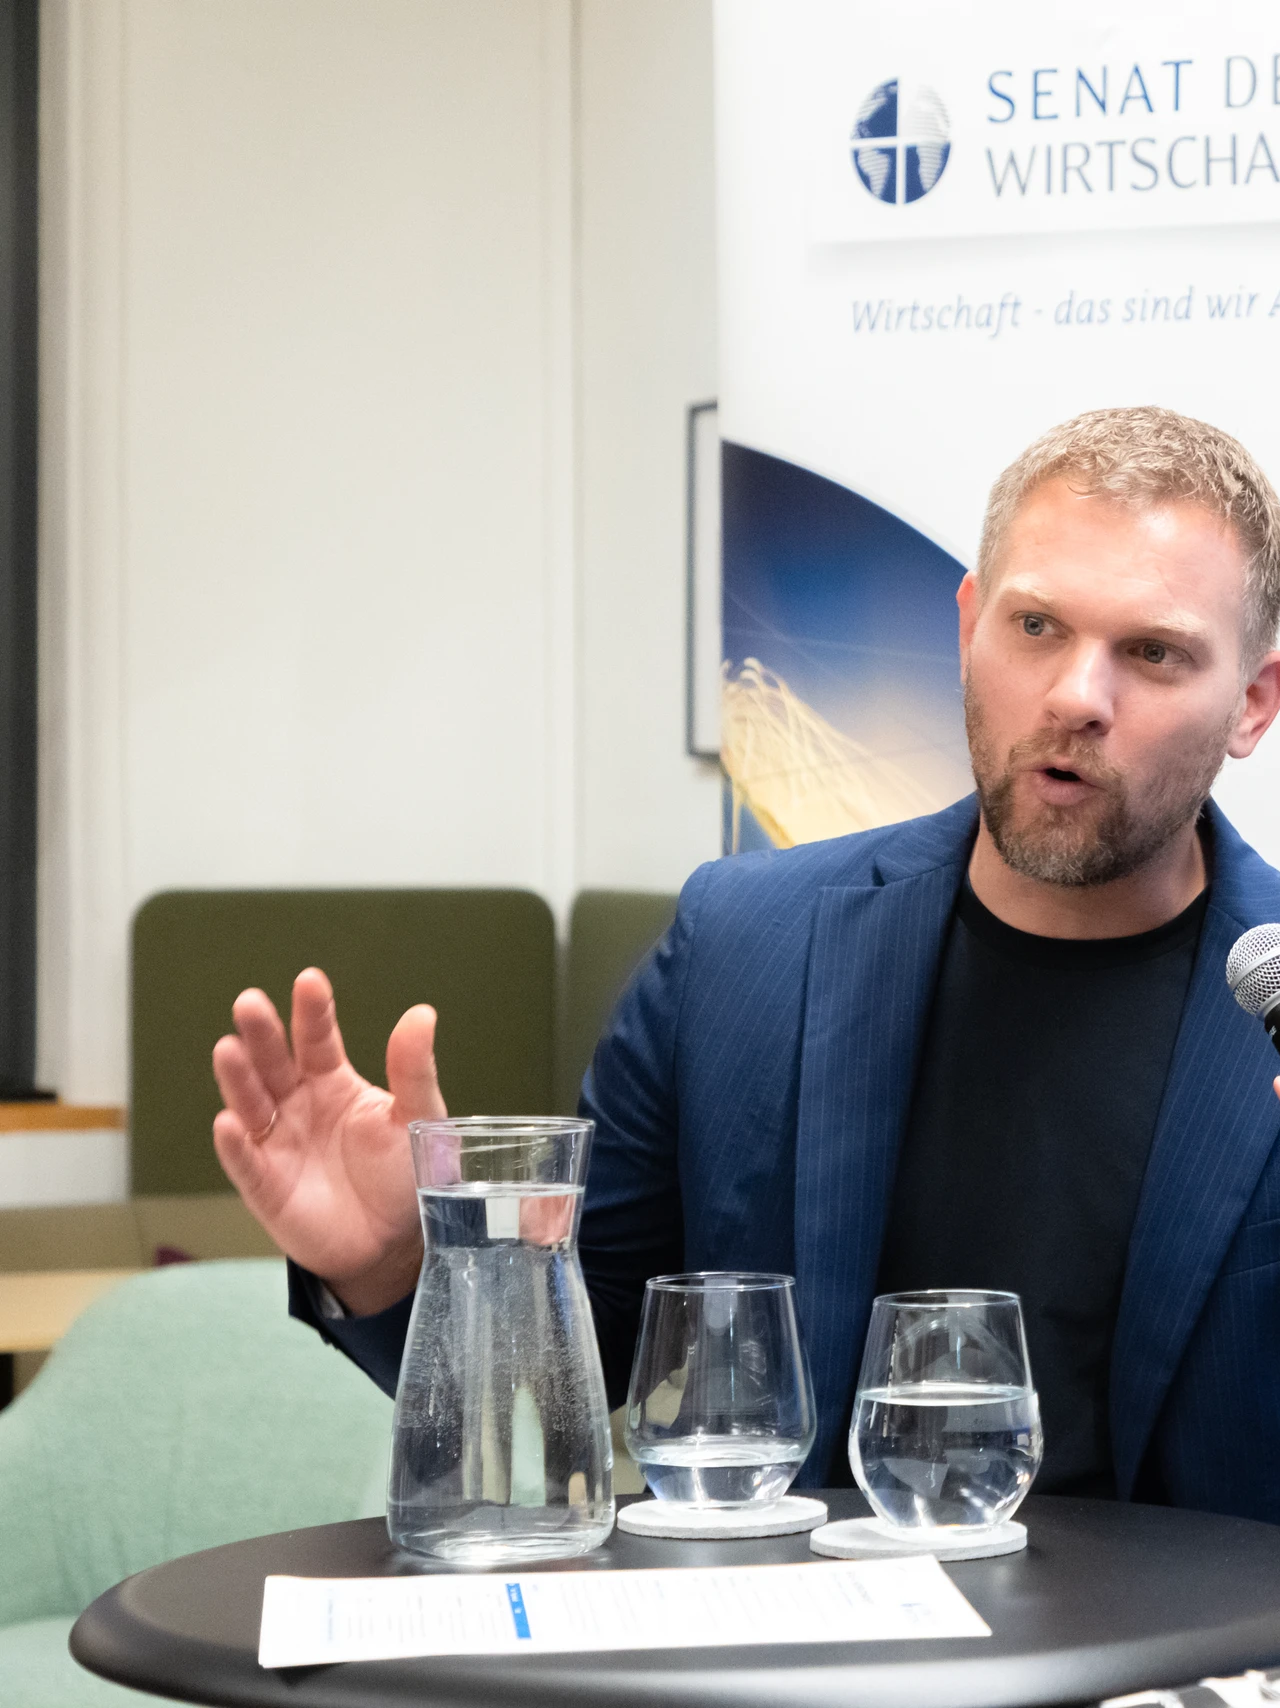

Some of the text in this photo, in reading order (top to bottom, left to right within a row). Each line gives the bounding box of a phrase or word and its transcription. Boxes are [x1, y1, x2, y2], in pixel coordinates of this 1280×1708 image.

[987, 59, 1193, 123] SENAT
[852, 291, 1022, 340] Wirtschaft
[1054, 289, 1111, 325] das
[1122, 284, 1195, 323] sind
[1207, 283, 1260, 319] wir
